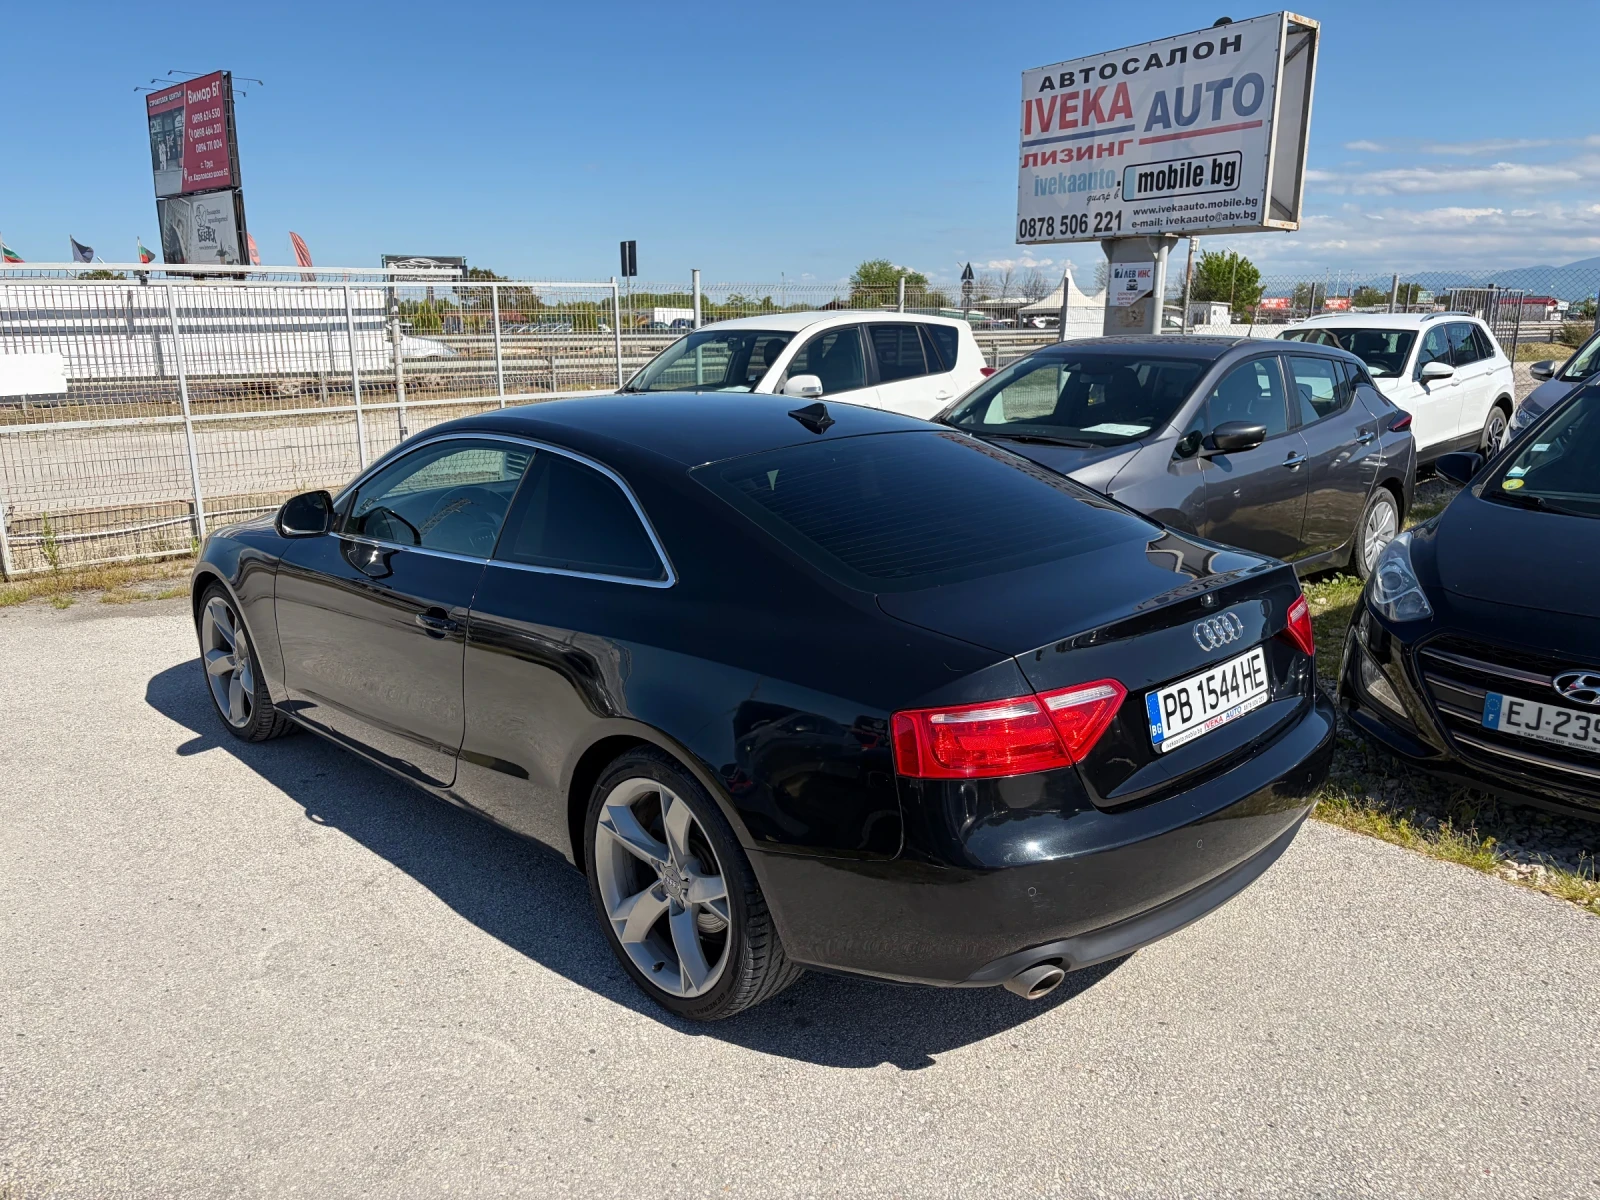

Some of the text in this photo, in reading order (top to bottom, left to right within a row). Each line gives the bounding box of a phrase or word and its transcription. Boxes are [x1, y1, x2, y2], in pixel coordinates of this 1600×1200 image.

[1039, 34, 1242, 92] АВТОСАЛОН
[187, 81, 220, 104] Вимар БГ
[1023, 72, 1265, 136] IVEKA AUTO
[1021, 139, 1134, 169] ЛИЗИНГ
[1137, 158, 1237, 194] mobile.bg
[1131, 210, 1257, 229] e-mail: ivekaauto@abv.bg
[1133, 197, 1258, 216] www.ivekaauto.mobile.bg
[1019, 210, 1123, 239] 0878 506 221
[1163, 688, 1194, 731] PB
[1203, 715, 1224, 730] IVEKA
[1225, 706, 1242, 720] AUTO
[1488, 714, 1494, 722] F
[1151, 723, 1162, 737] BG
